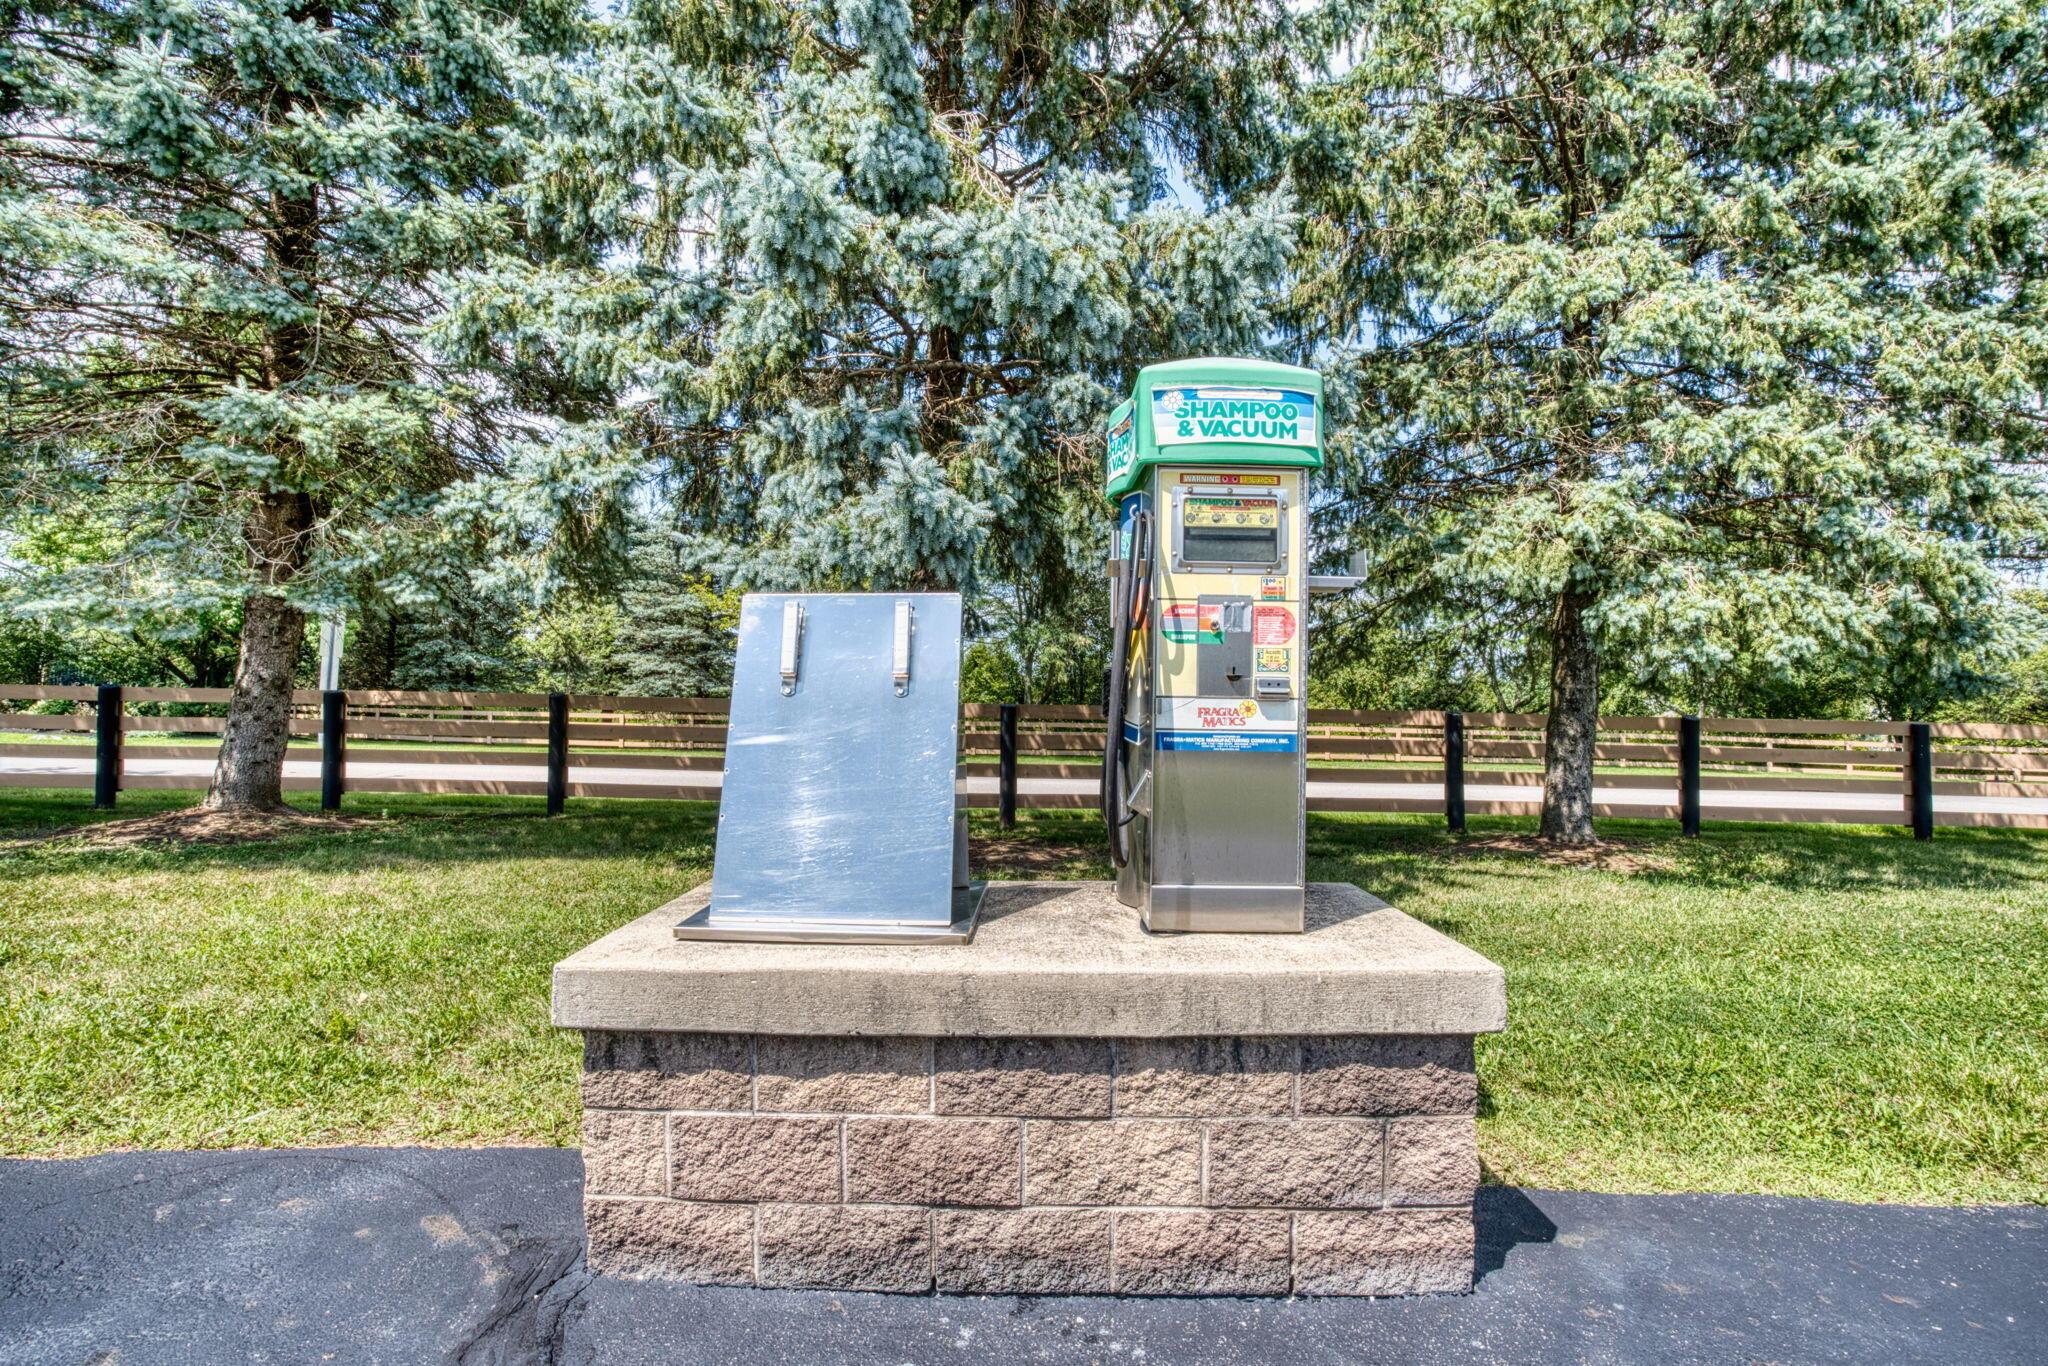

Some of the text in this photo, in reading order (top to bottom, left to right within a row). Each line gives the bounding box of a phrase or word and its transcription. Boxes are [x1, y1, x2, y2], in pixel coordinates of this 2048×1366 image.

[1174, 400, 1299, 421] SHAMPOO
[1177, 419, 1299, 440] & VACUUM
[1197, 707, 1240, 718] FRAGRA
[1202, 716, 1247, 728] MATICS
